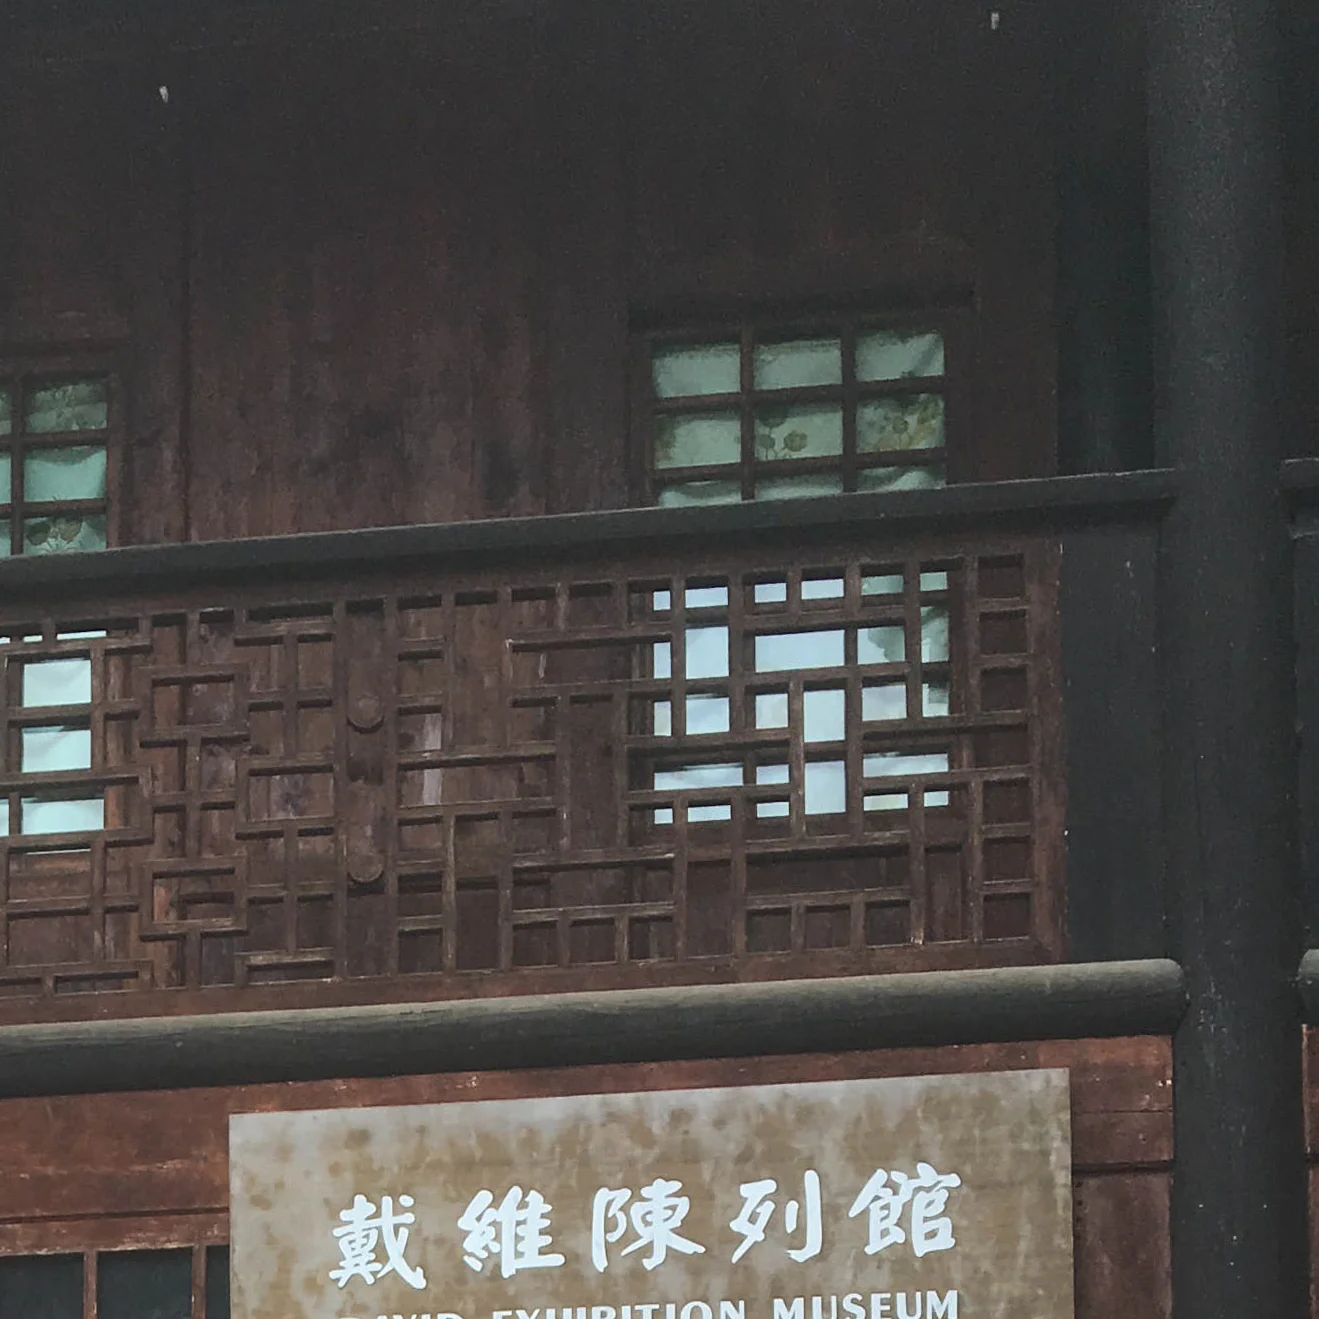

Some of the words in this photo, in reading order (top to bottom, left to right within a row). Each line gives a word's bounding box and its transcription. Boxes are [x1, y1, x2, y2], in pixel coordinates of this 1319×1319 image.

[329, 1162, 963, 1291] 戴維陳列館
